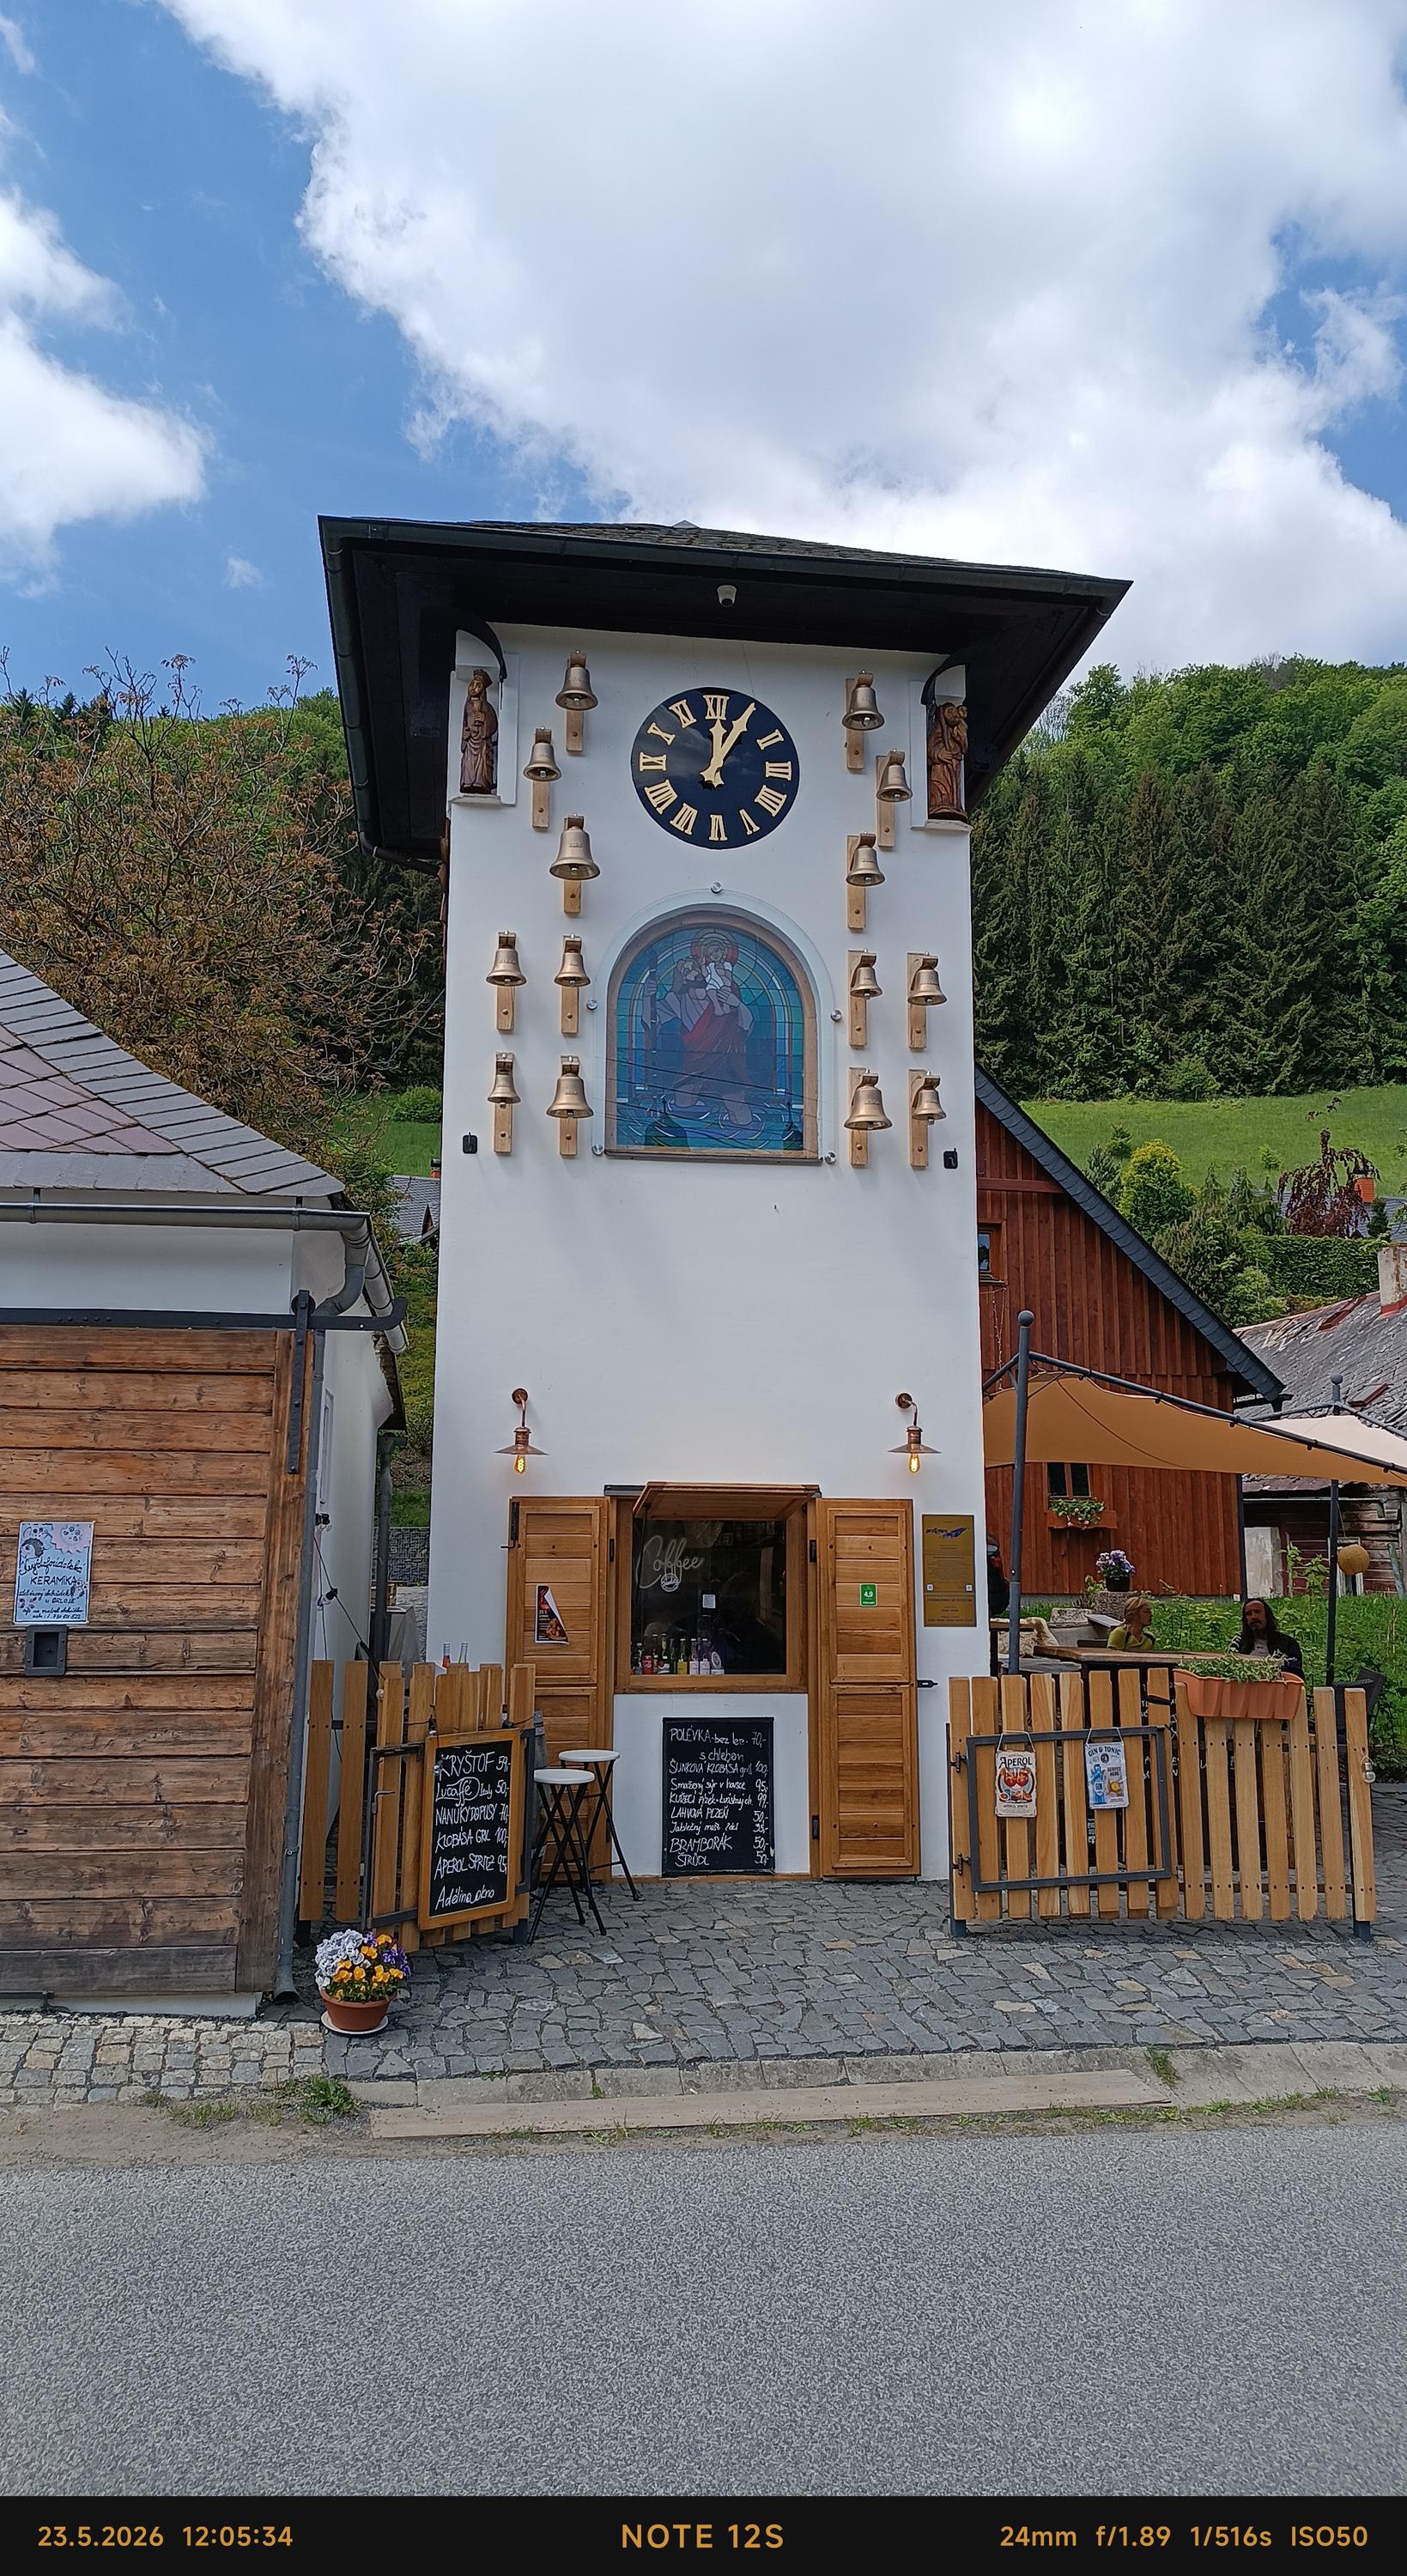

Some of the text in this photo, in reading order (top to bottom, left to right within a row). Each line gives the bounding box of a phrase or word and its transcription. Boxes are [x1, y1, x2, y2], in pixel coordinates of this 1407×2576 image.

[669, 699, 696, 728] XI
[703, 696, 729, 720] XII
[647, 722, 676, 745] X
[756, 729, 784, 750] II
[640, 752, 666, 771] IX
[766, 761, 791, 781] III
[645, 780, 677, 814] VIII
[755, 785, 786, 817] IIII
[670, 803, 698, 835] VII
[709, 815, 728, 841] VI
[739, 809, 760, 835] V
[636, 1535, 704, 1589] Coffee
[30, 1576, 76, 1585] KERAMIKA
[998, 1756, 1033, 1770] APEROL
[1088, 1747, 1098, 1757] GIN
[1104, 1746, 1121, 1756] TONIC
[670, 1777, 705, 1795] Smažený
[705, 1805, 729, 1820] PLZEŇ
[435, 1826, 474, 1854] KLOBÁSA
[669, 1832, 733, 1853] BRAMBORÁK
[434, 1856, 468, 1880] APEROL
[675, 1851, 710, 1867] ŠTRŮDL
